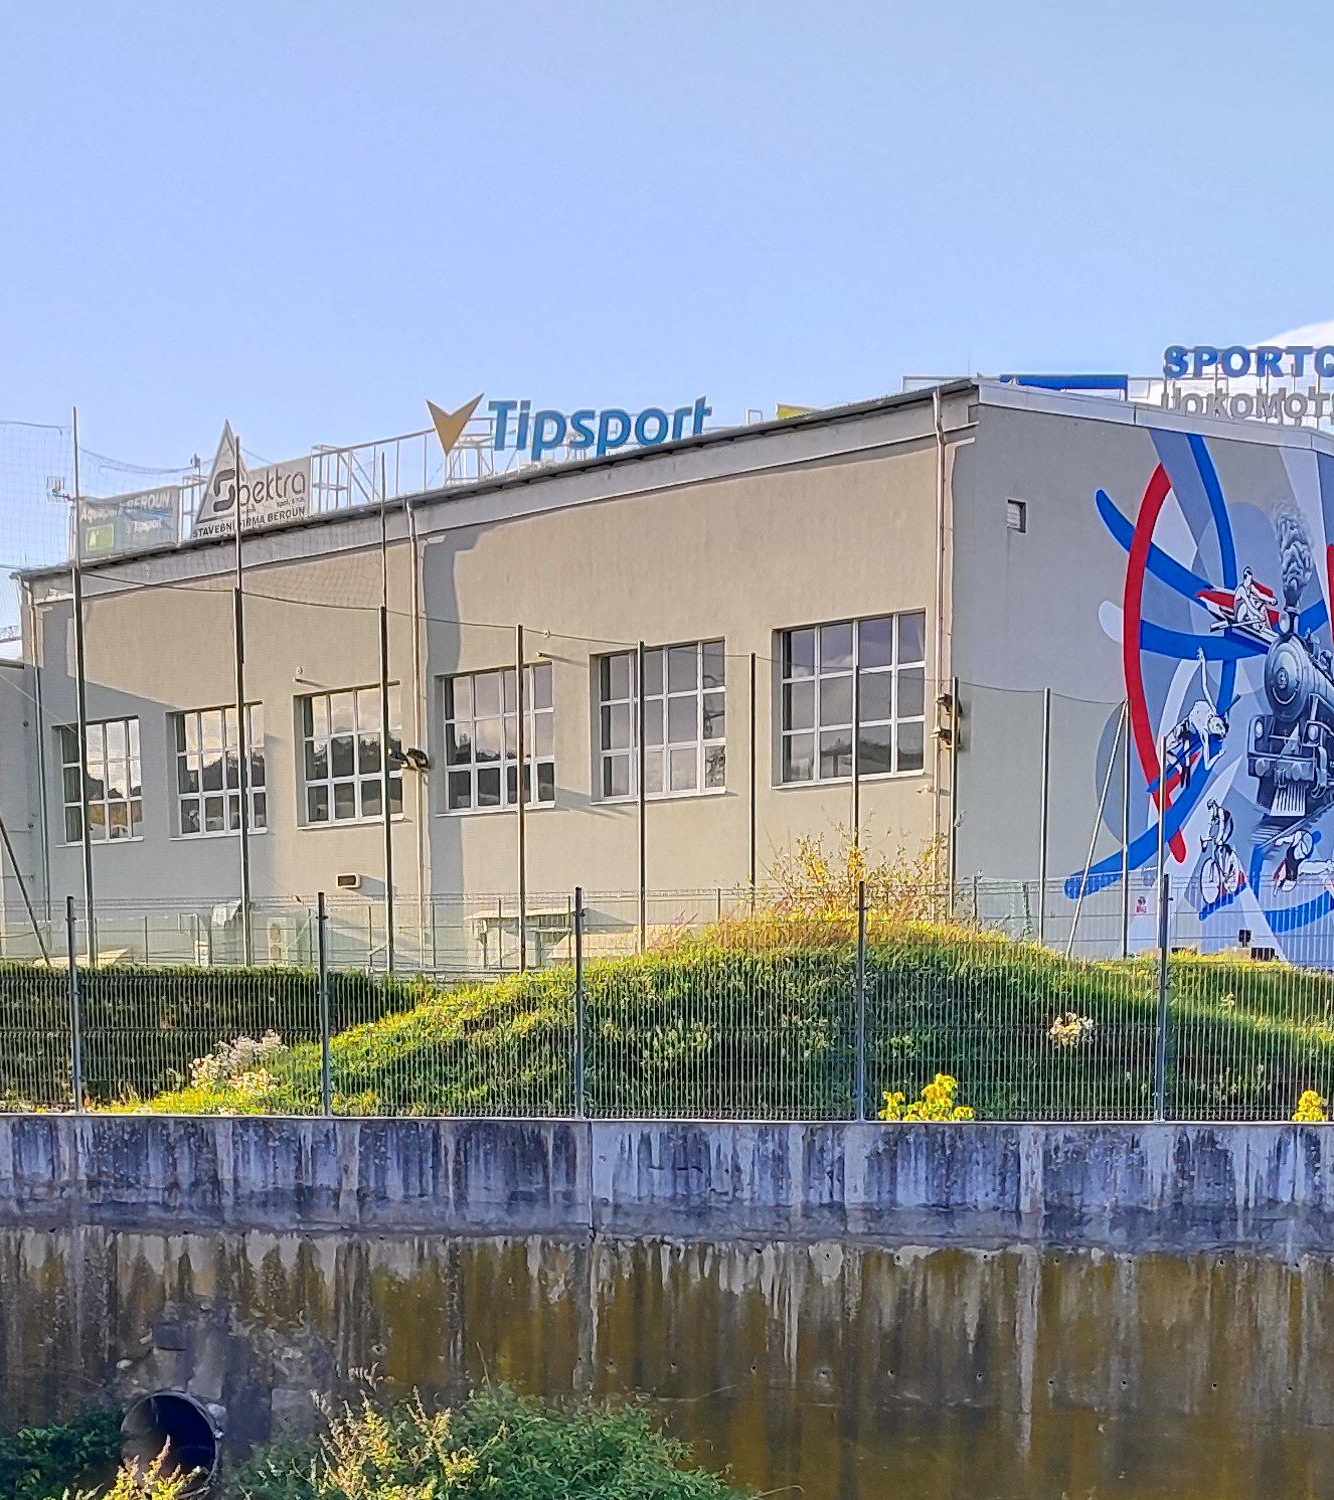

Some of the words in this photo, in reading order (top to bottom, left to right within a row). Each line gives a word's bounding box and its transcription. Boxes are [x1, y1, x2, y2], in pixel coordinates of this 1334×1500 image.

[488, 396, 713, 461] Tipsport
[238, 515, 265, 530] IRMA
[267, 506, 305, 523] BEROUN
